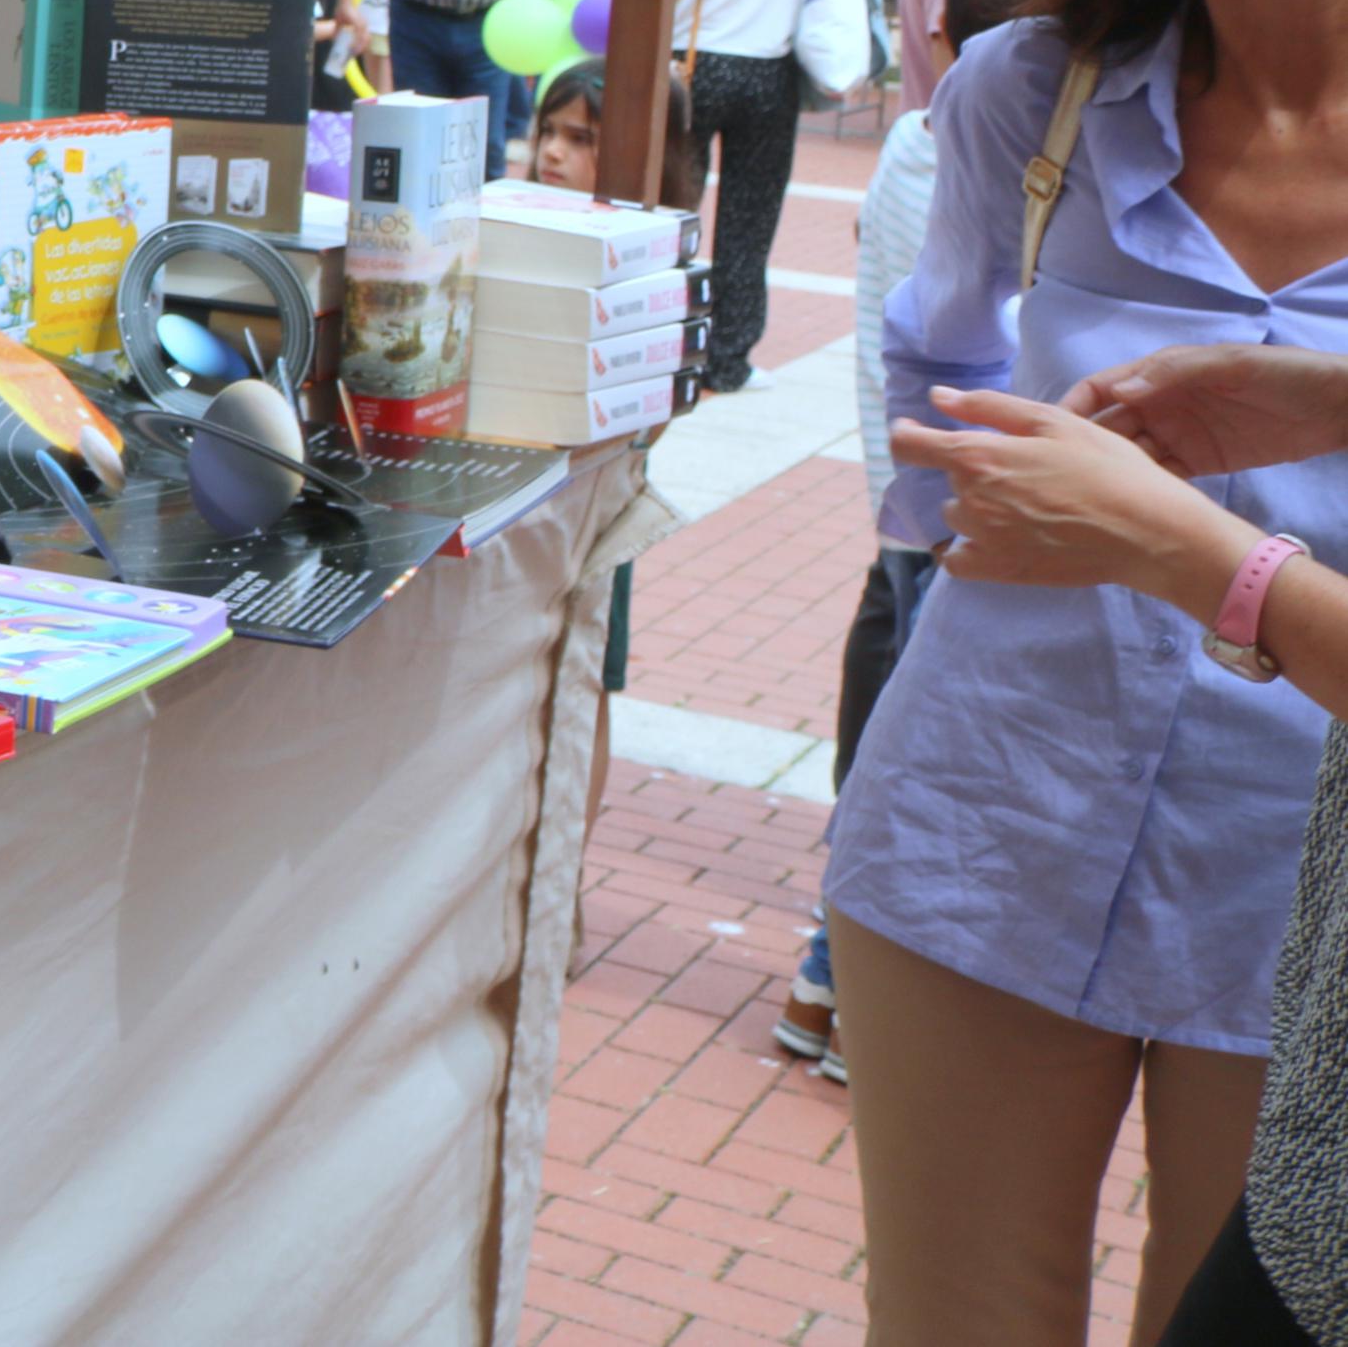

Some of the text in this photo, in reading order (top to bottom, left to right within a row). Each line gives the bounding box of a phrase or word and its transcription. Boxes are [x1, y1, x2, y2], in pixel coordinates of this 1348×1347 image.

[44, 234, 123, 259] Las divertidas
[44, 260, 122, 284] vacaciones
[49, 289, 66, 304] de
[67, 287, 82, 302] las
